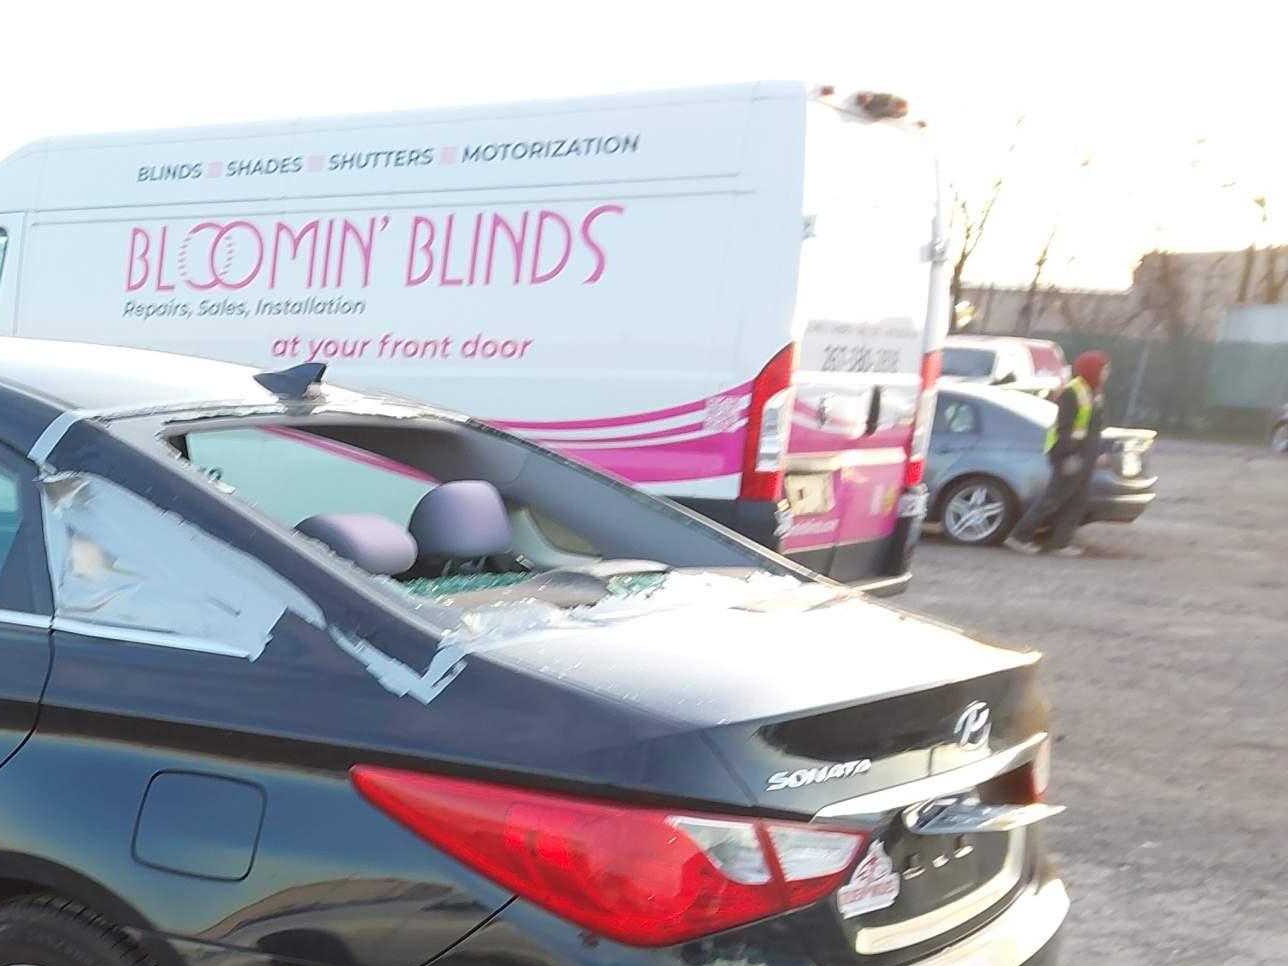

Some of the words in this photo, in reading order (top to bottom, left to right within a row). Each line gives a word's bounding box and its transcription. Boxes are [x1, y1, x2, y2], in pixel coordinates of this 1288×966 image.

[136, 161, 204, 183] BLINDS
[225, 155, 304, 178] SHADES
[327, 147, 435, 173] SHUTTERS
[460, 133, 641, 164] MOTORIZATION
[403, 203, 626, 288] BLINDS
[122, 296, 194, 321] Repairs,
[196, 297, 251, 319] Sales,
[254, 295, 367, 317] Installation
[270, 334, 300, 359] at
[306, 335, 372, 363] your
[376, 332, 452, 360] front
[460, 331, 534, 360] door
[766, 757, 872, 792] SONATA
